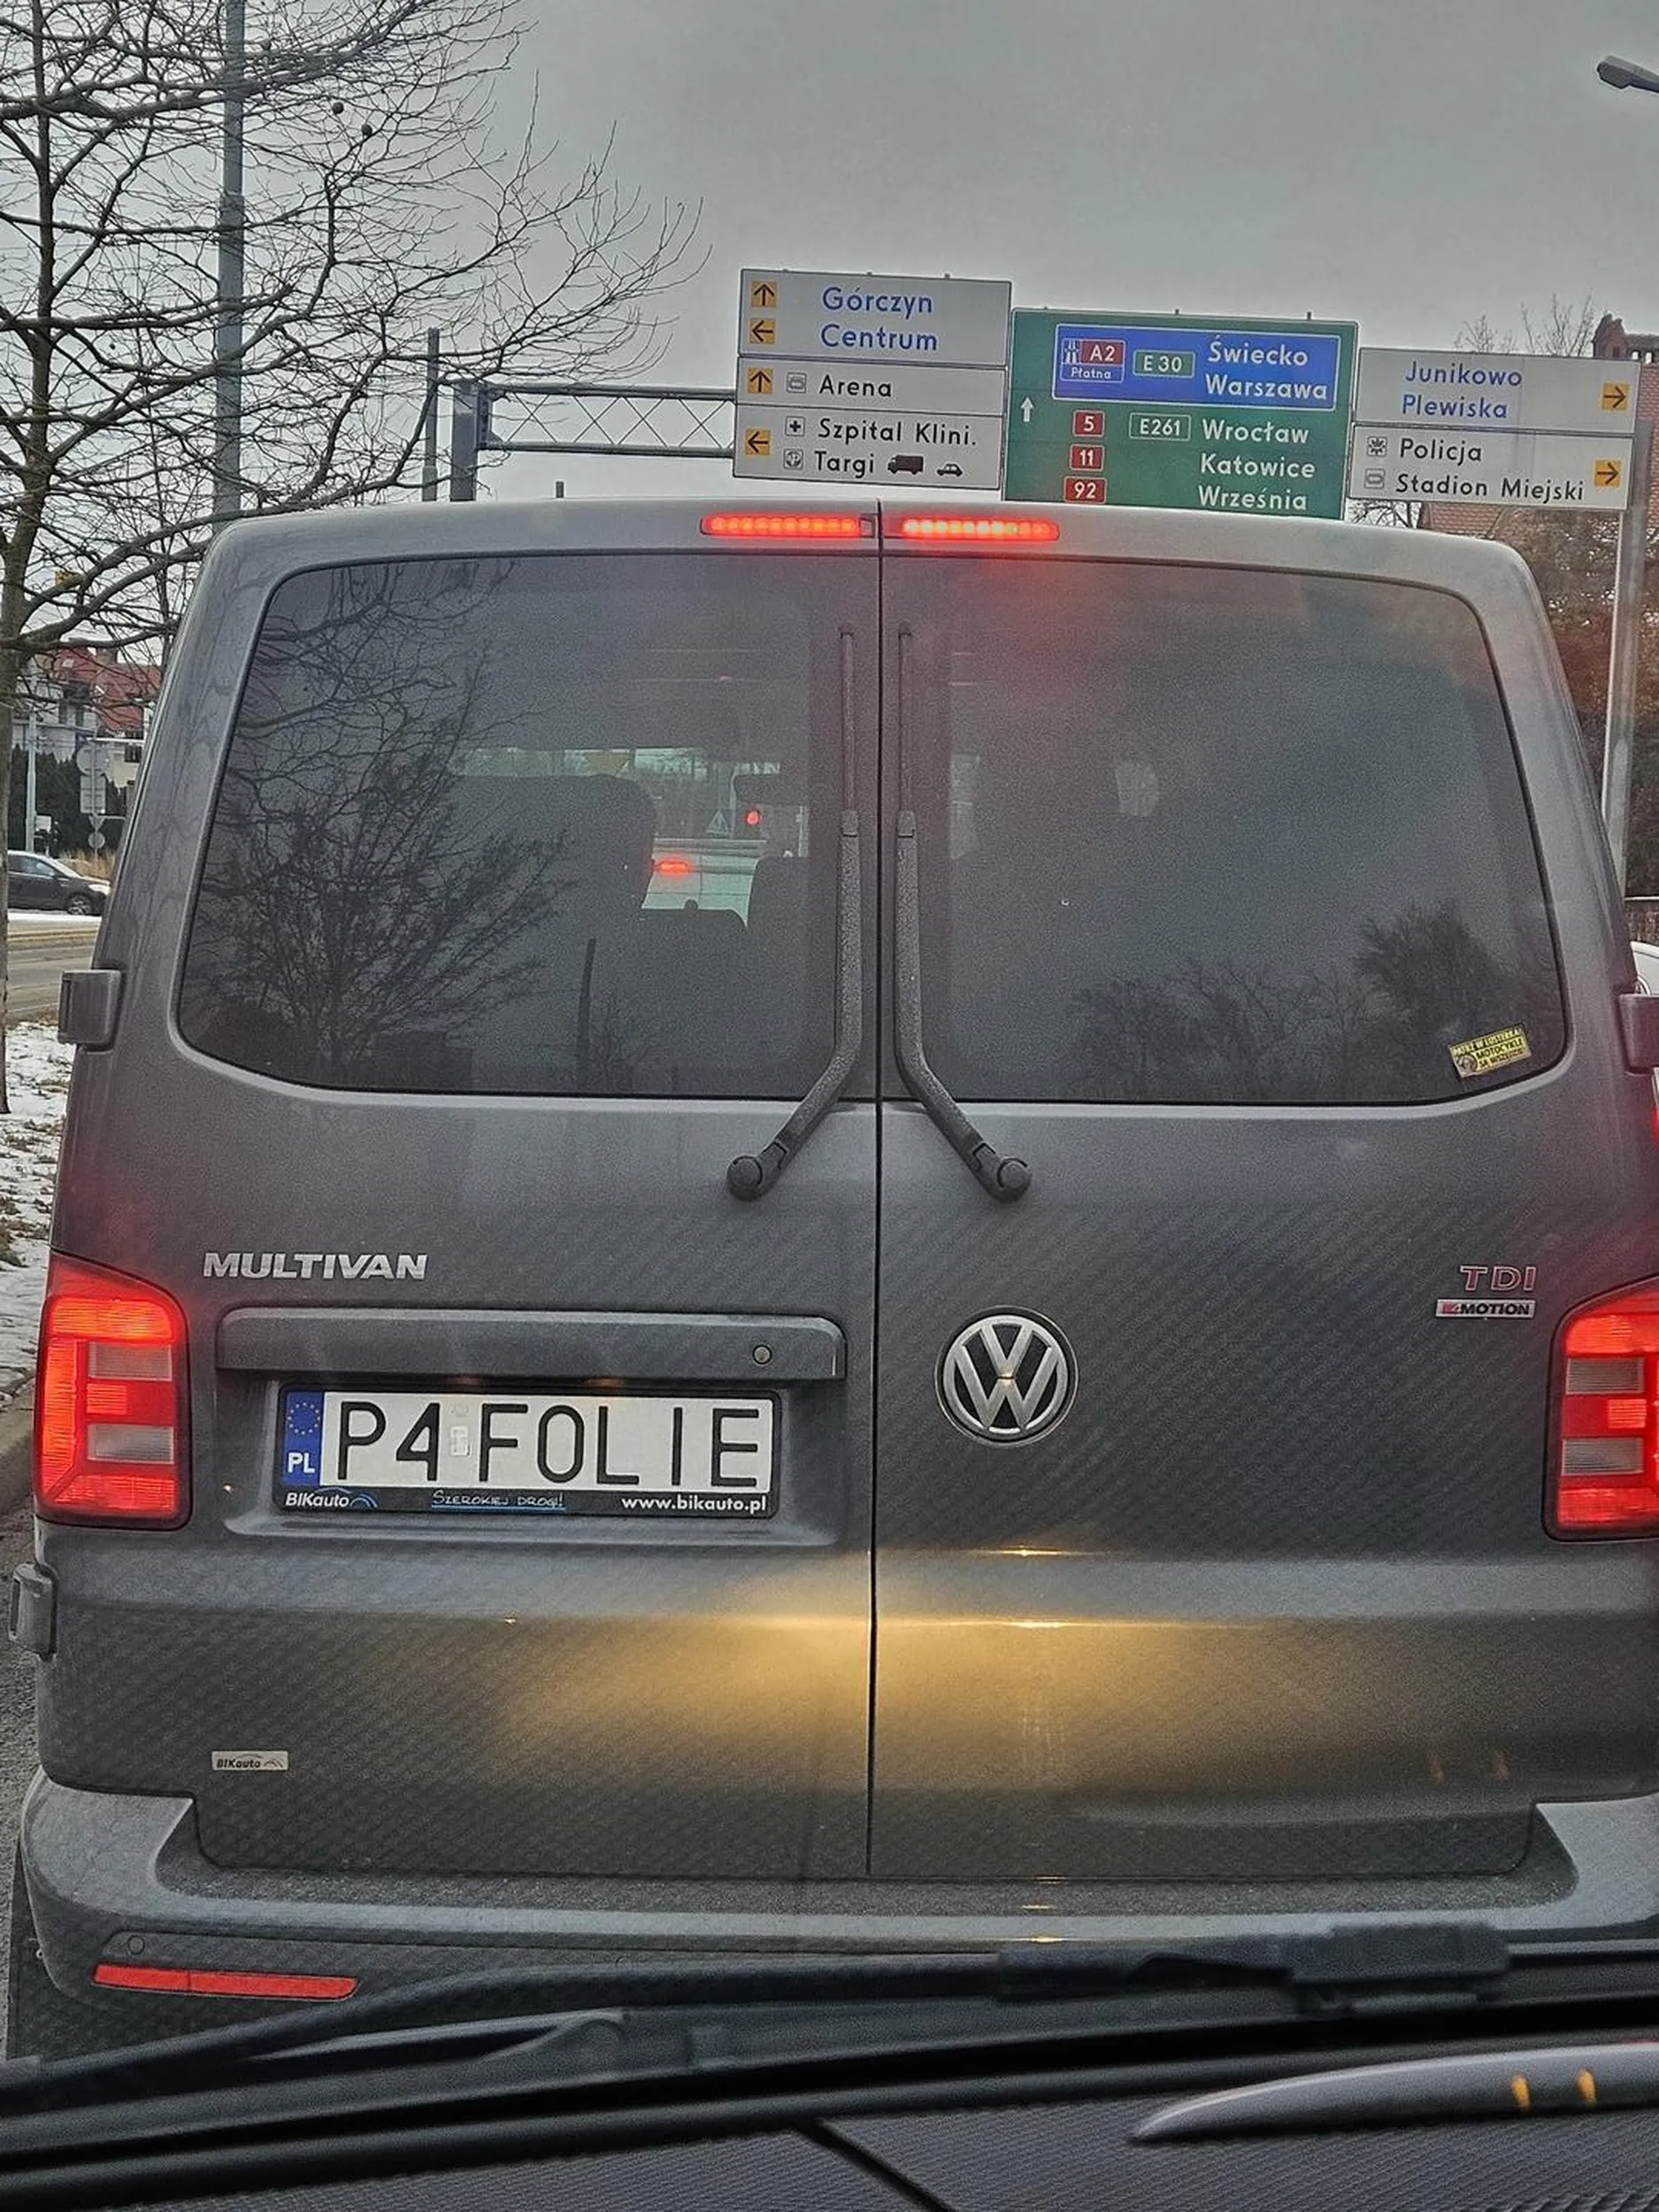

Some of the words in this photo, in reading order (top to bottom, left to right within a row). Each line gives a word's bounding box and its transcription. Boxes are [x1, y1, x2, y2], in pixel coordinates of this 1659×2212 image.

[822, 286, 933, 319] Górczyn
[821, 324, 938, 351] Centrum
[1208, 335, 1308, 366] Świecko
[1089, 344, 1115, 362] A2
[819, 374, 892, 397] Arena
[1071, 366, 1112, 380] Płatna
[1406, 361, 1522, 387] Junikowo
[1205, 373, 1327, 400] Warszawa
[1402, 395, 1508, 419] Plewiska
[818, 418, 902, 446] Szpital
[917, 422, 977, 446] Klini.
[1082, 415, 1094, 433] 5
[1201, 419, 1309, 444] Wrocław
[814, 450, 875, 479] Targi
[1079, 449, 1094, 466] 11
[1400, 438, 1482, 465] Policja
[1201, 452, 1316, 479] Katowice
[1073, 481, 1095, 499] 92
[1198, 485, 1308, 511] Września
[1395, 472, 1488, 497] Stadion
[1501, 477, 1584, 504] Miejski
[203, 1252, 427, 1279] MULTIVAN
[1460, 1265, 1537, 1291] TDI
[338, 1402, 441, 1482] P4
[288, 1452, 315, 1473] PL
[285, 1492, 349, 1507] BIKauto
[622, 1494, 766, 1515] www.bikauto.pl
[217, 1758, 261, 1769] BIKauto
